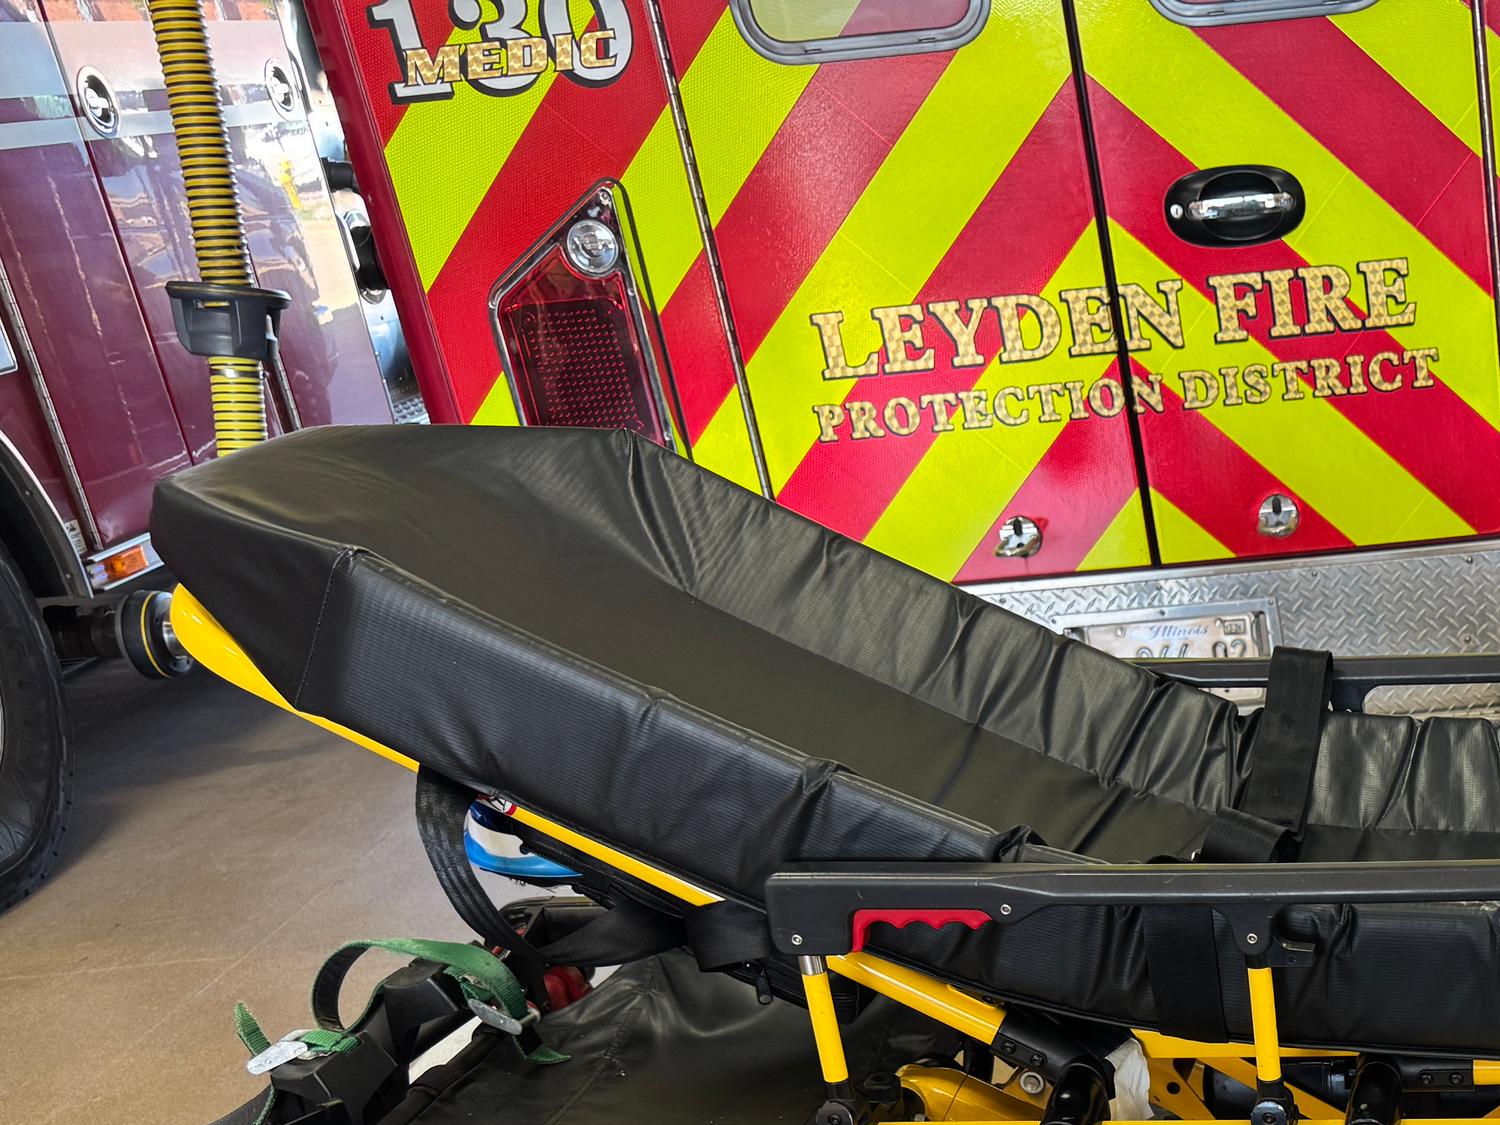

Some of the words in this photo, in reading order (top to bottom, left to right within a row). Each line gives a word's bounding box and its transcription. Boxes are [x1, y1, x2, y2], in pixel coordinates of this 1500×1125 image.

[366, 0, 634, 104] 130
[403, 28, 618, 88] MEDIC
[810, 279, 1185, 381] LEYDEN
[1208, 257, 1417, 345] FIRE
[812, 373, 1165, 443] PROTECTION
[1180, 347, 1440, 411] DISTRICT
[1149, 624, 1209, 640] Illinois
